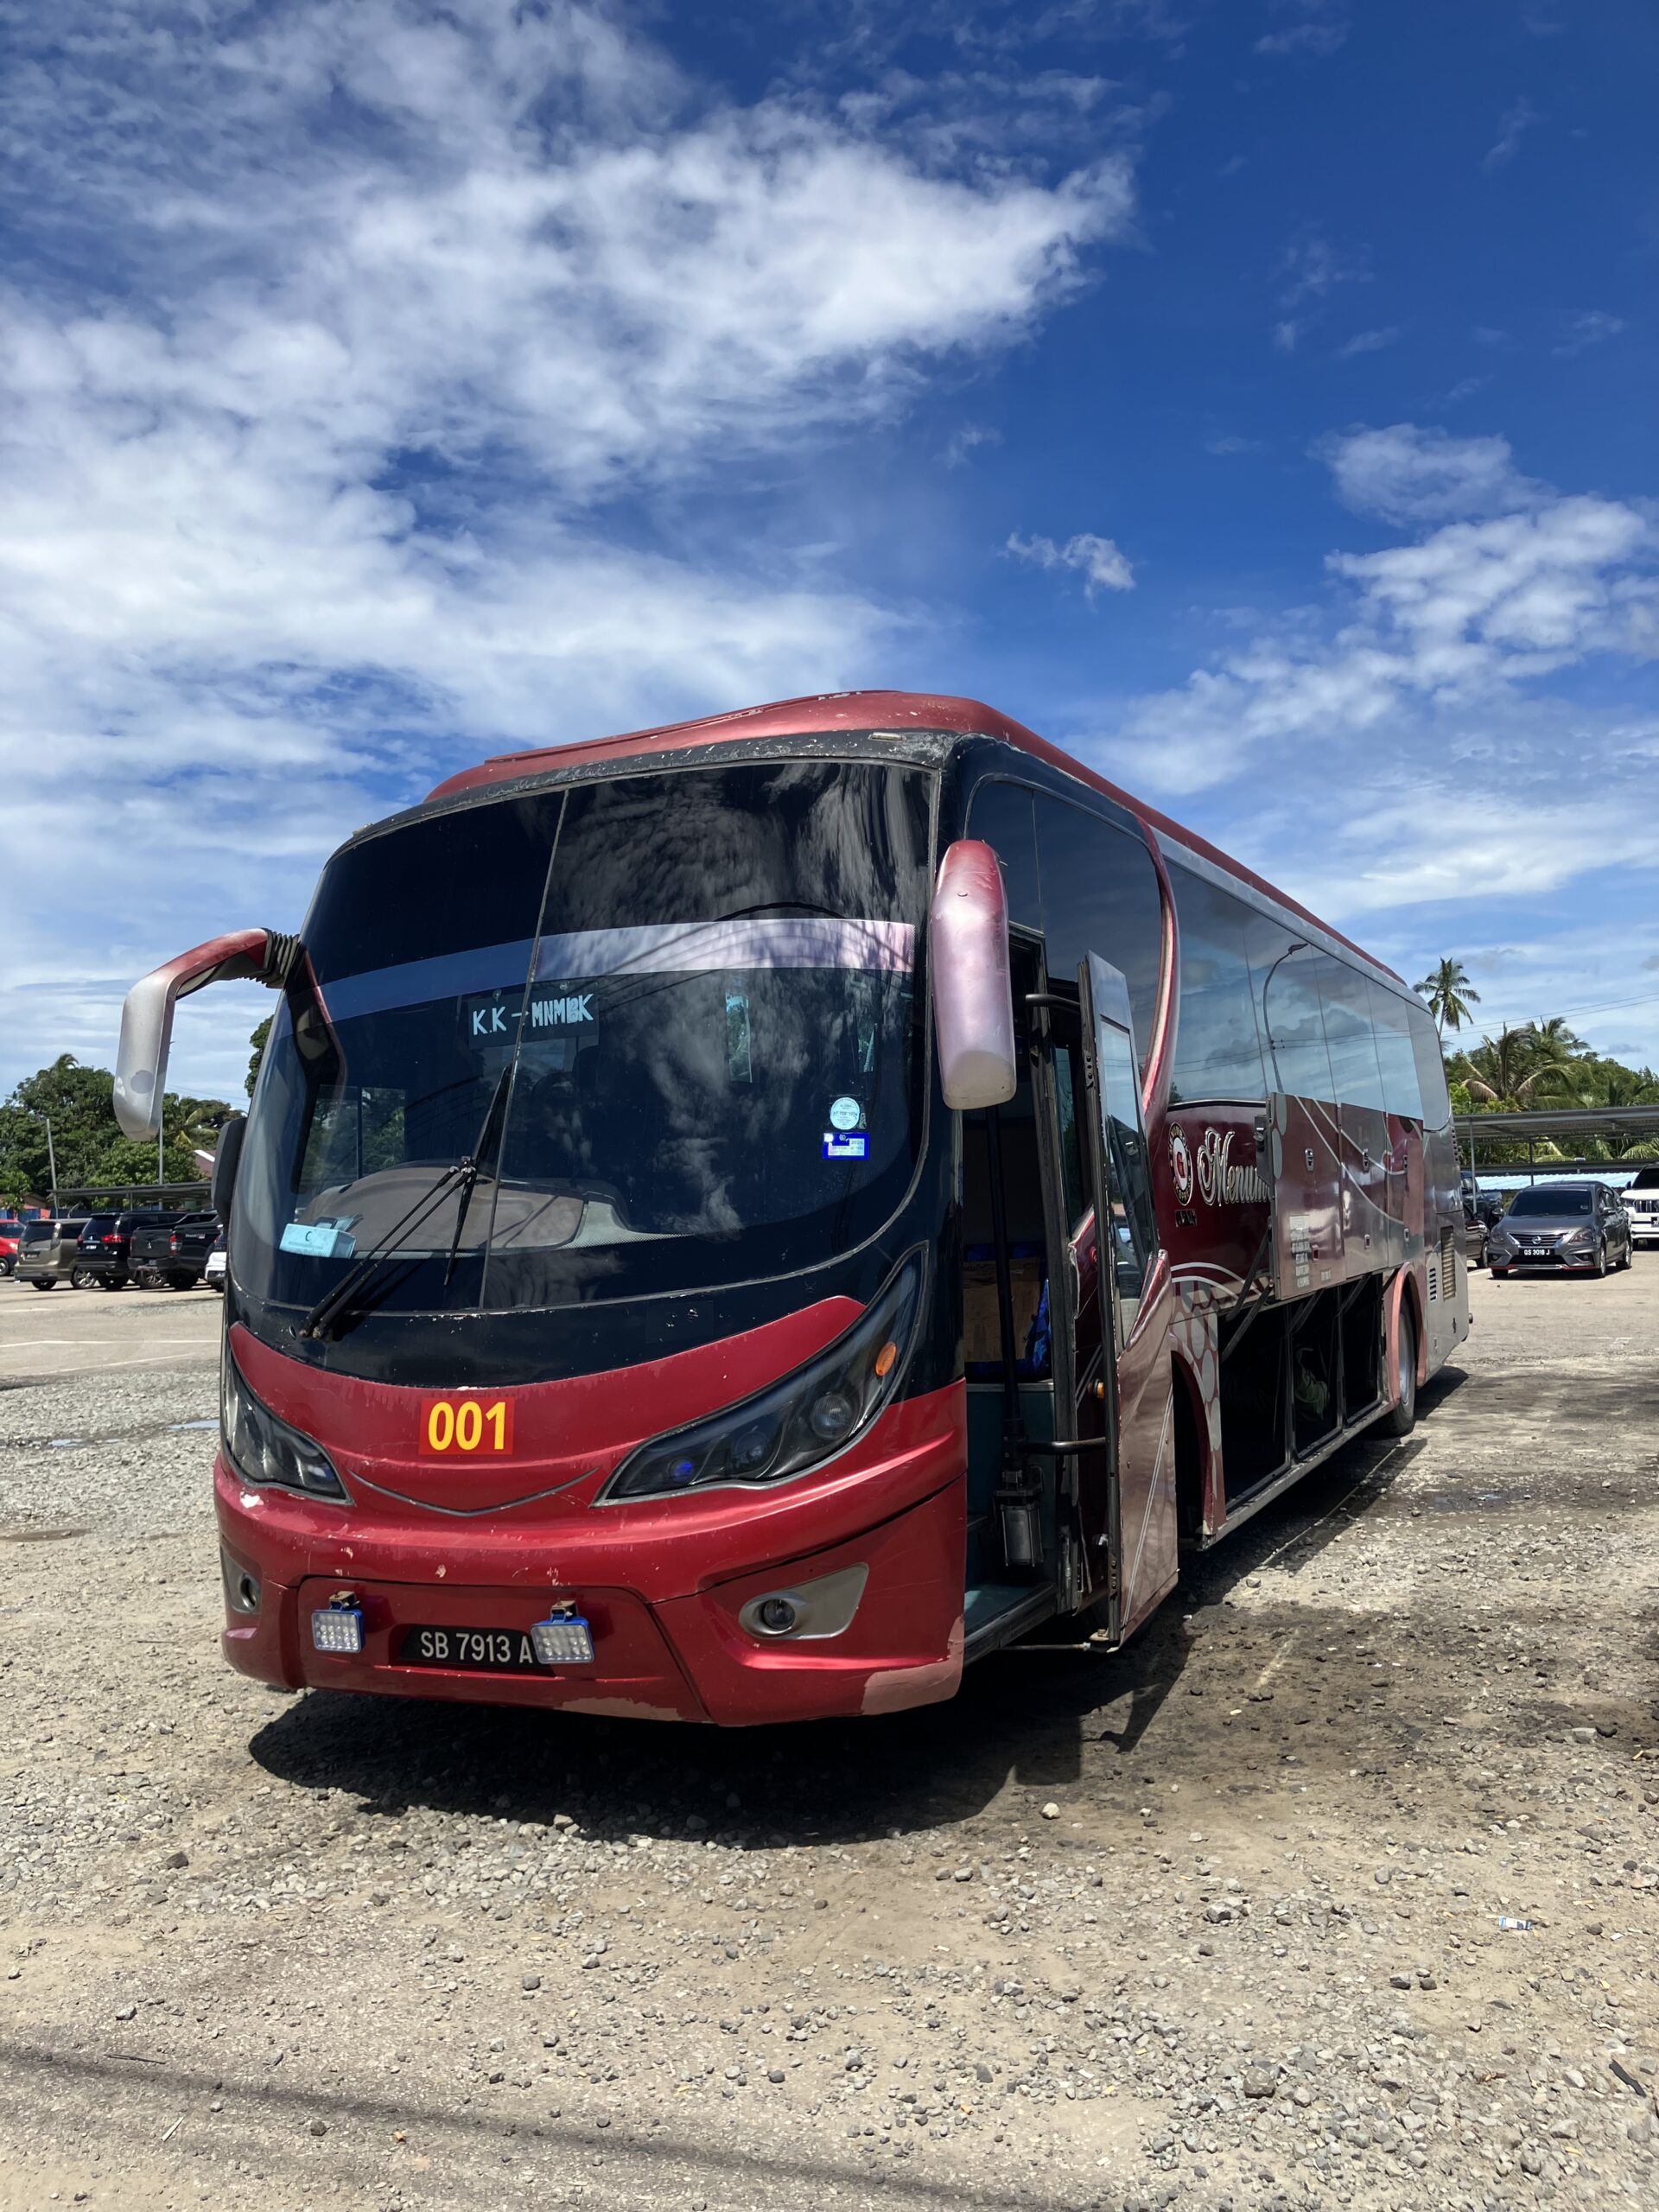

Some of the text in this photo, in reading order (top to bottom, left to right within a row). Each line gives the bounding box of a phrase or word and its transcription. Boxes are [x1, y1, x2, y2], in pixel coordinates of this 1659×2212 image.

[473, 1006, 507, 1035] K.K
[428, 1401, 506, 1451] 001
[420, 1631, 534, 1664] SB 7913 A
